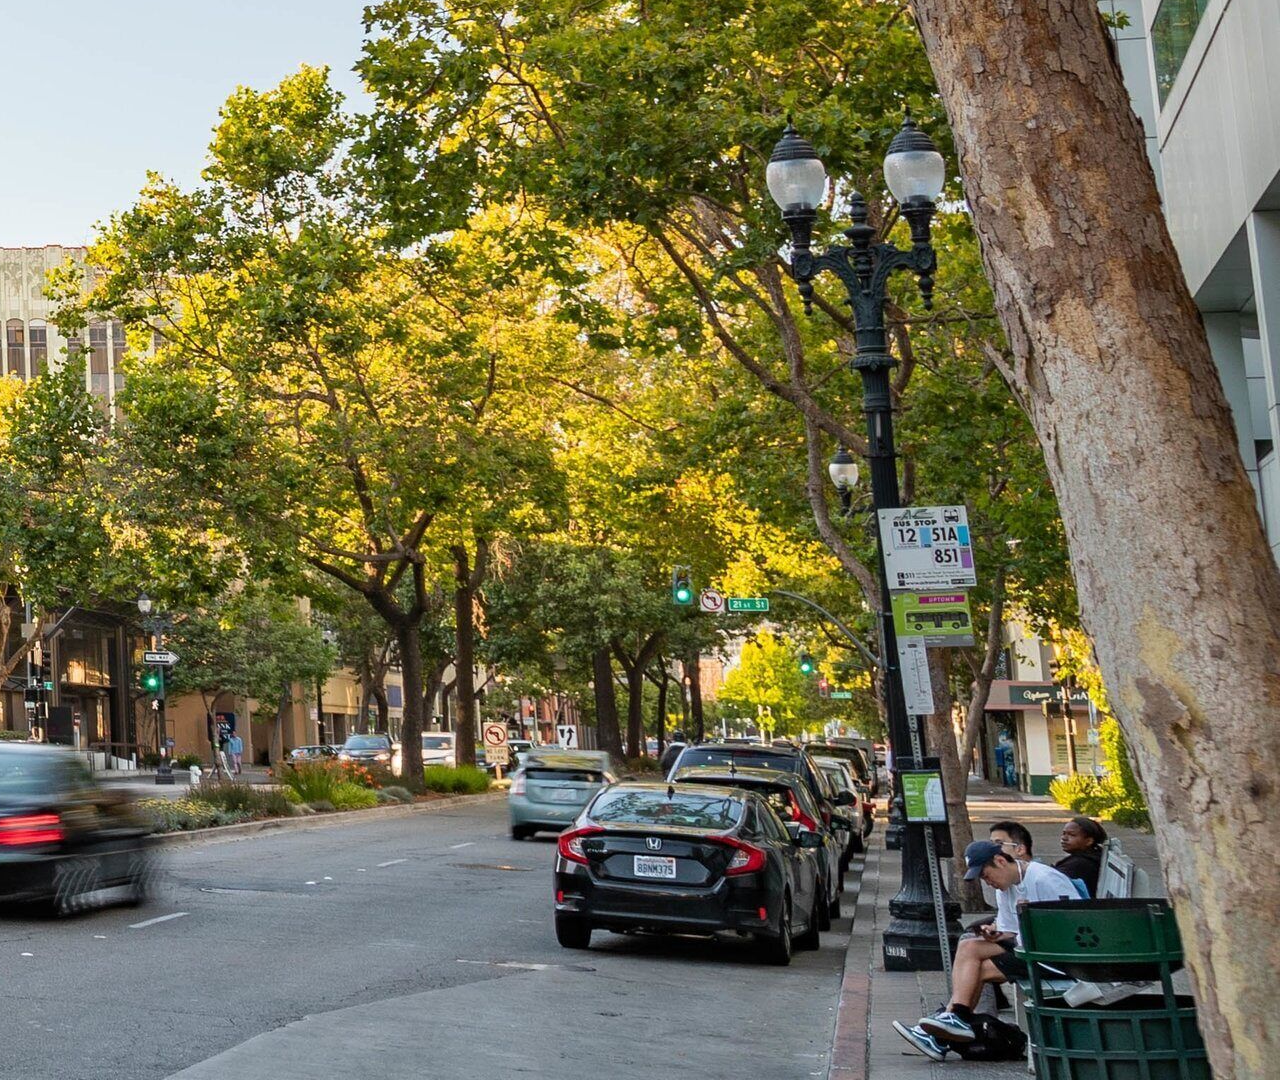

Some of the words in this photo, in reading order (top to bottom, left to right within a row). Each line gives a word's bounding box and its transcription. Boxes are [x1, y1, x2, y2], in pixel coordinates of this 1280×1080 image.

[898, 528, 917, 542] 12
[932, 527, 958, 541] 51A
[934, 548, 958, 563] 851
[755, 601, 765, 609] St
